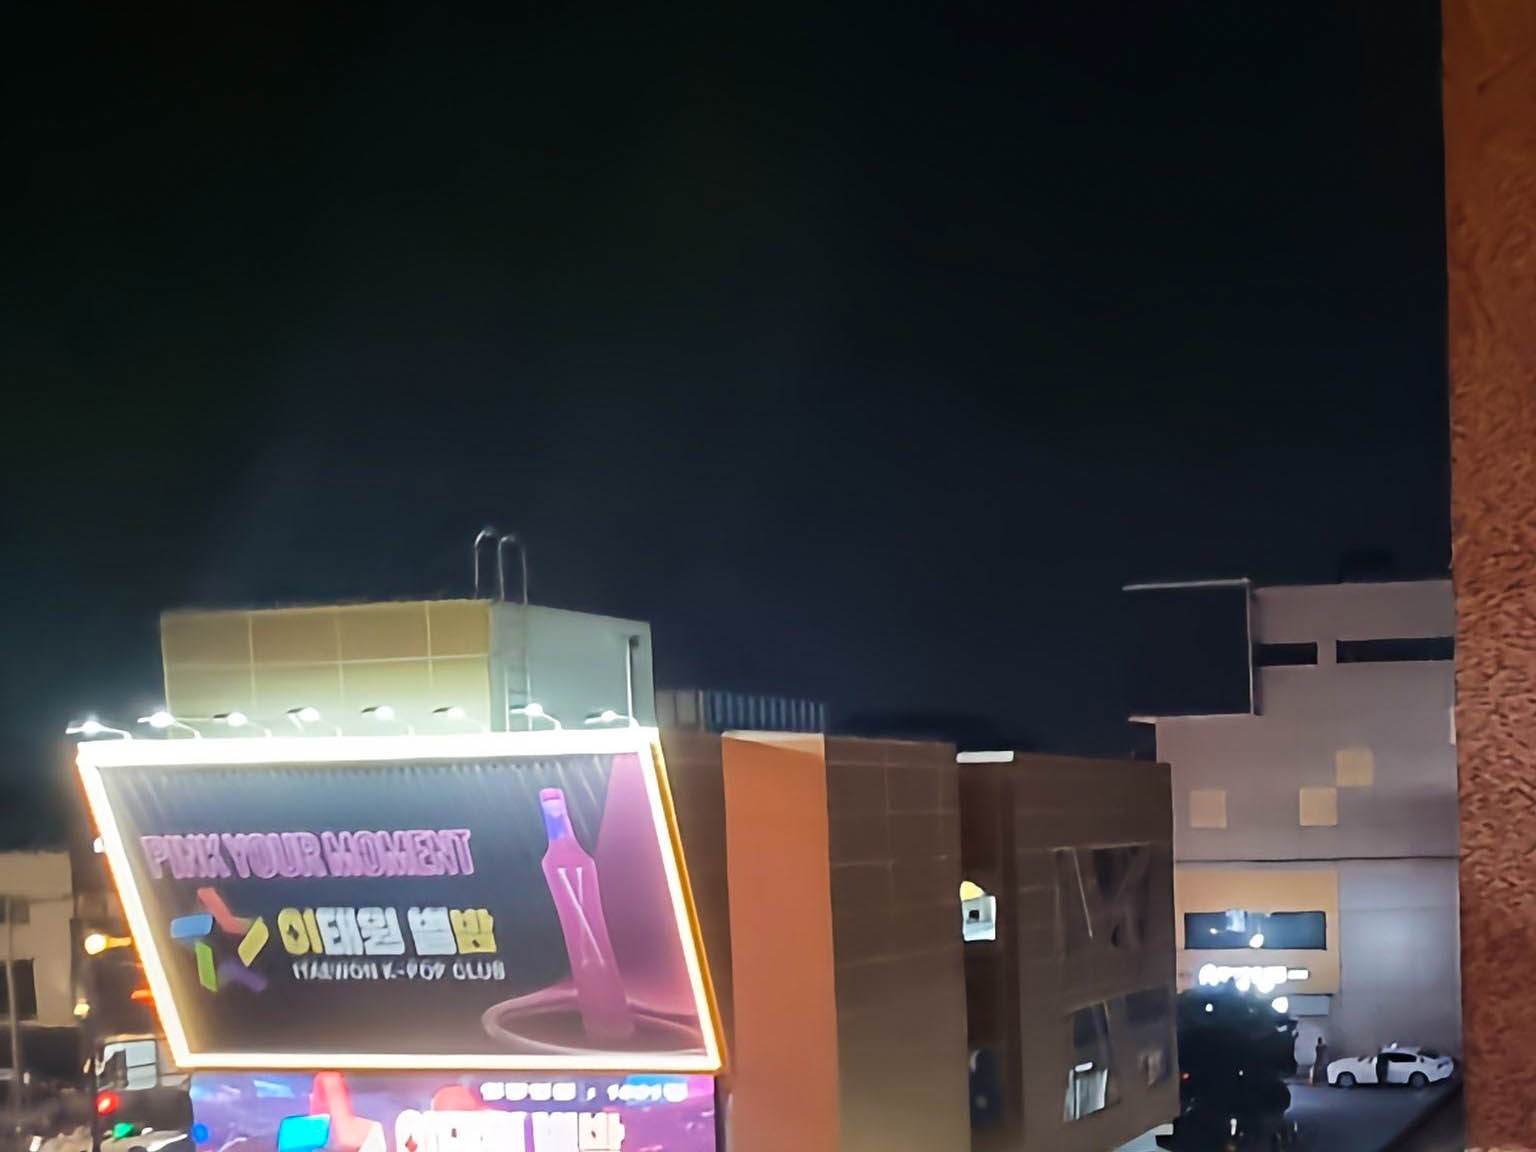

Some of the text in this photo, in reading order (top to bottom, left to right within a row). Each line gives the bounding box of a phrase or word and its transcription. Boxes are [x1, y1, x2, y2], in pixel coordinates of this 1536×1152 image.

[221, 832, 327, 878] YOUR
[320, 829, 475, 877] MOMENT
[277, 907, 406, 956] 이태원
[452, 959, 506, 981] CLUB
